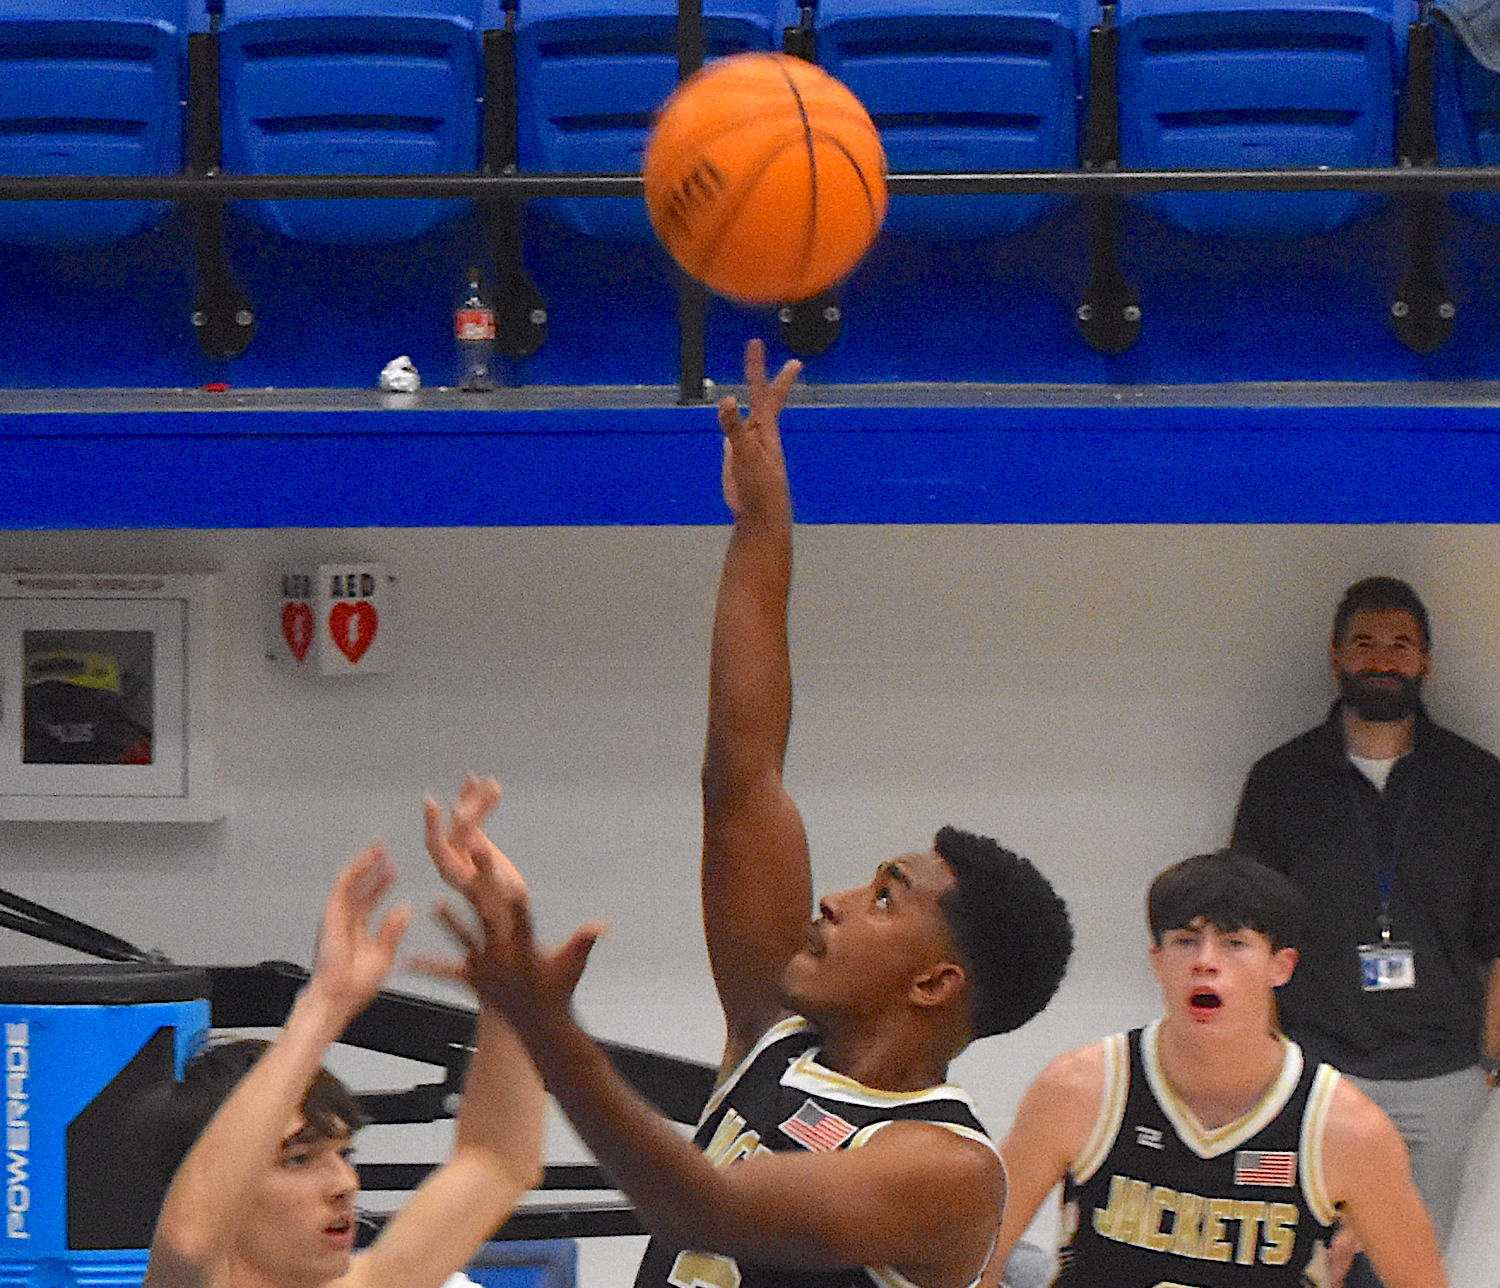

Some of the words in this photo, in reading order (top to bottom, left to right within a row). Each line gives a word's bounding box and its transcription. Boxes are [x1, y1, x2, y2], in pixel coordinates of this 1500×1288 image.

[331, 572, 376, 599] AED
[5, 1020, 31, 1239] POWERADE
[1092, 1174, 1300, 1266] JACKETS
